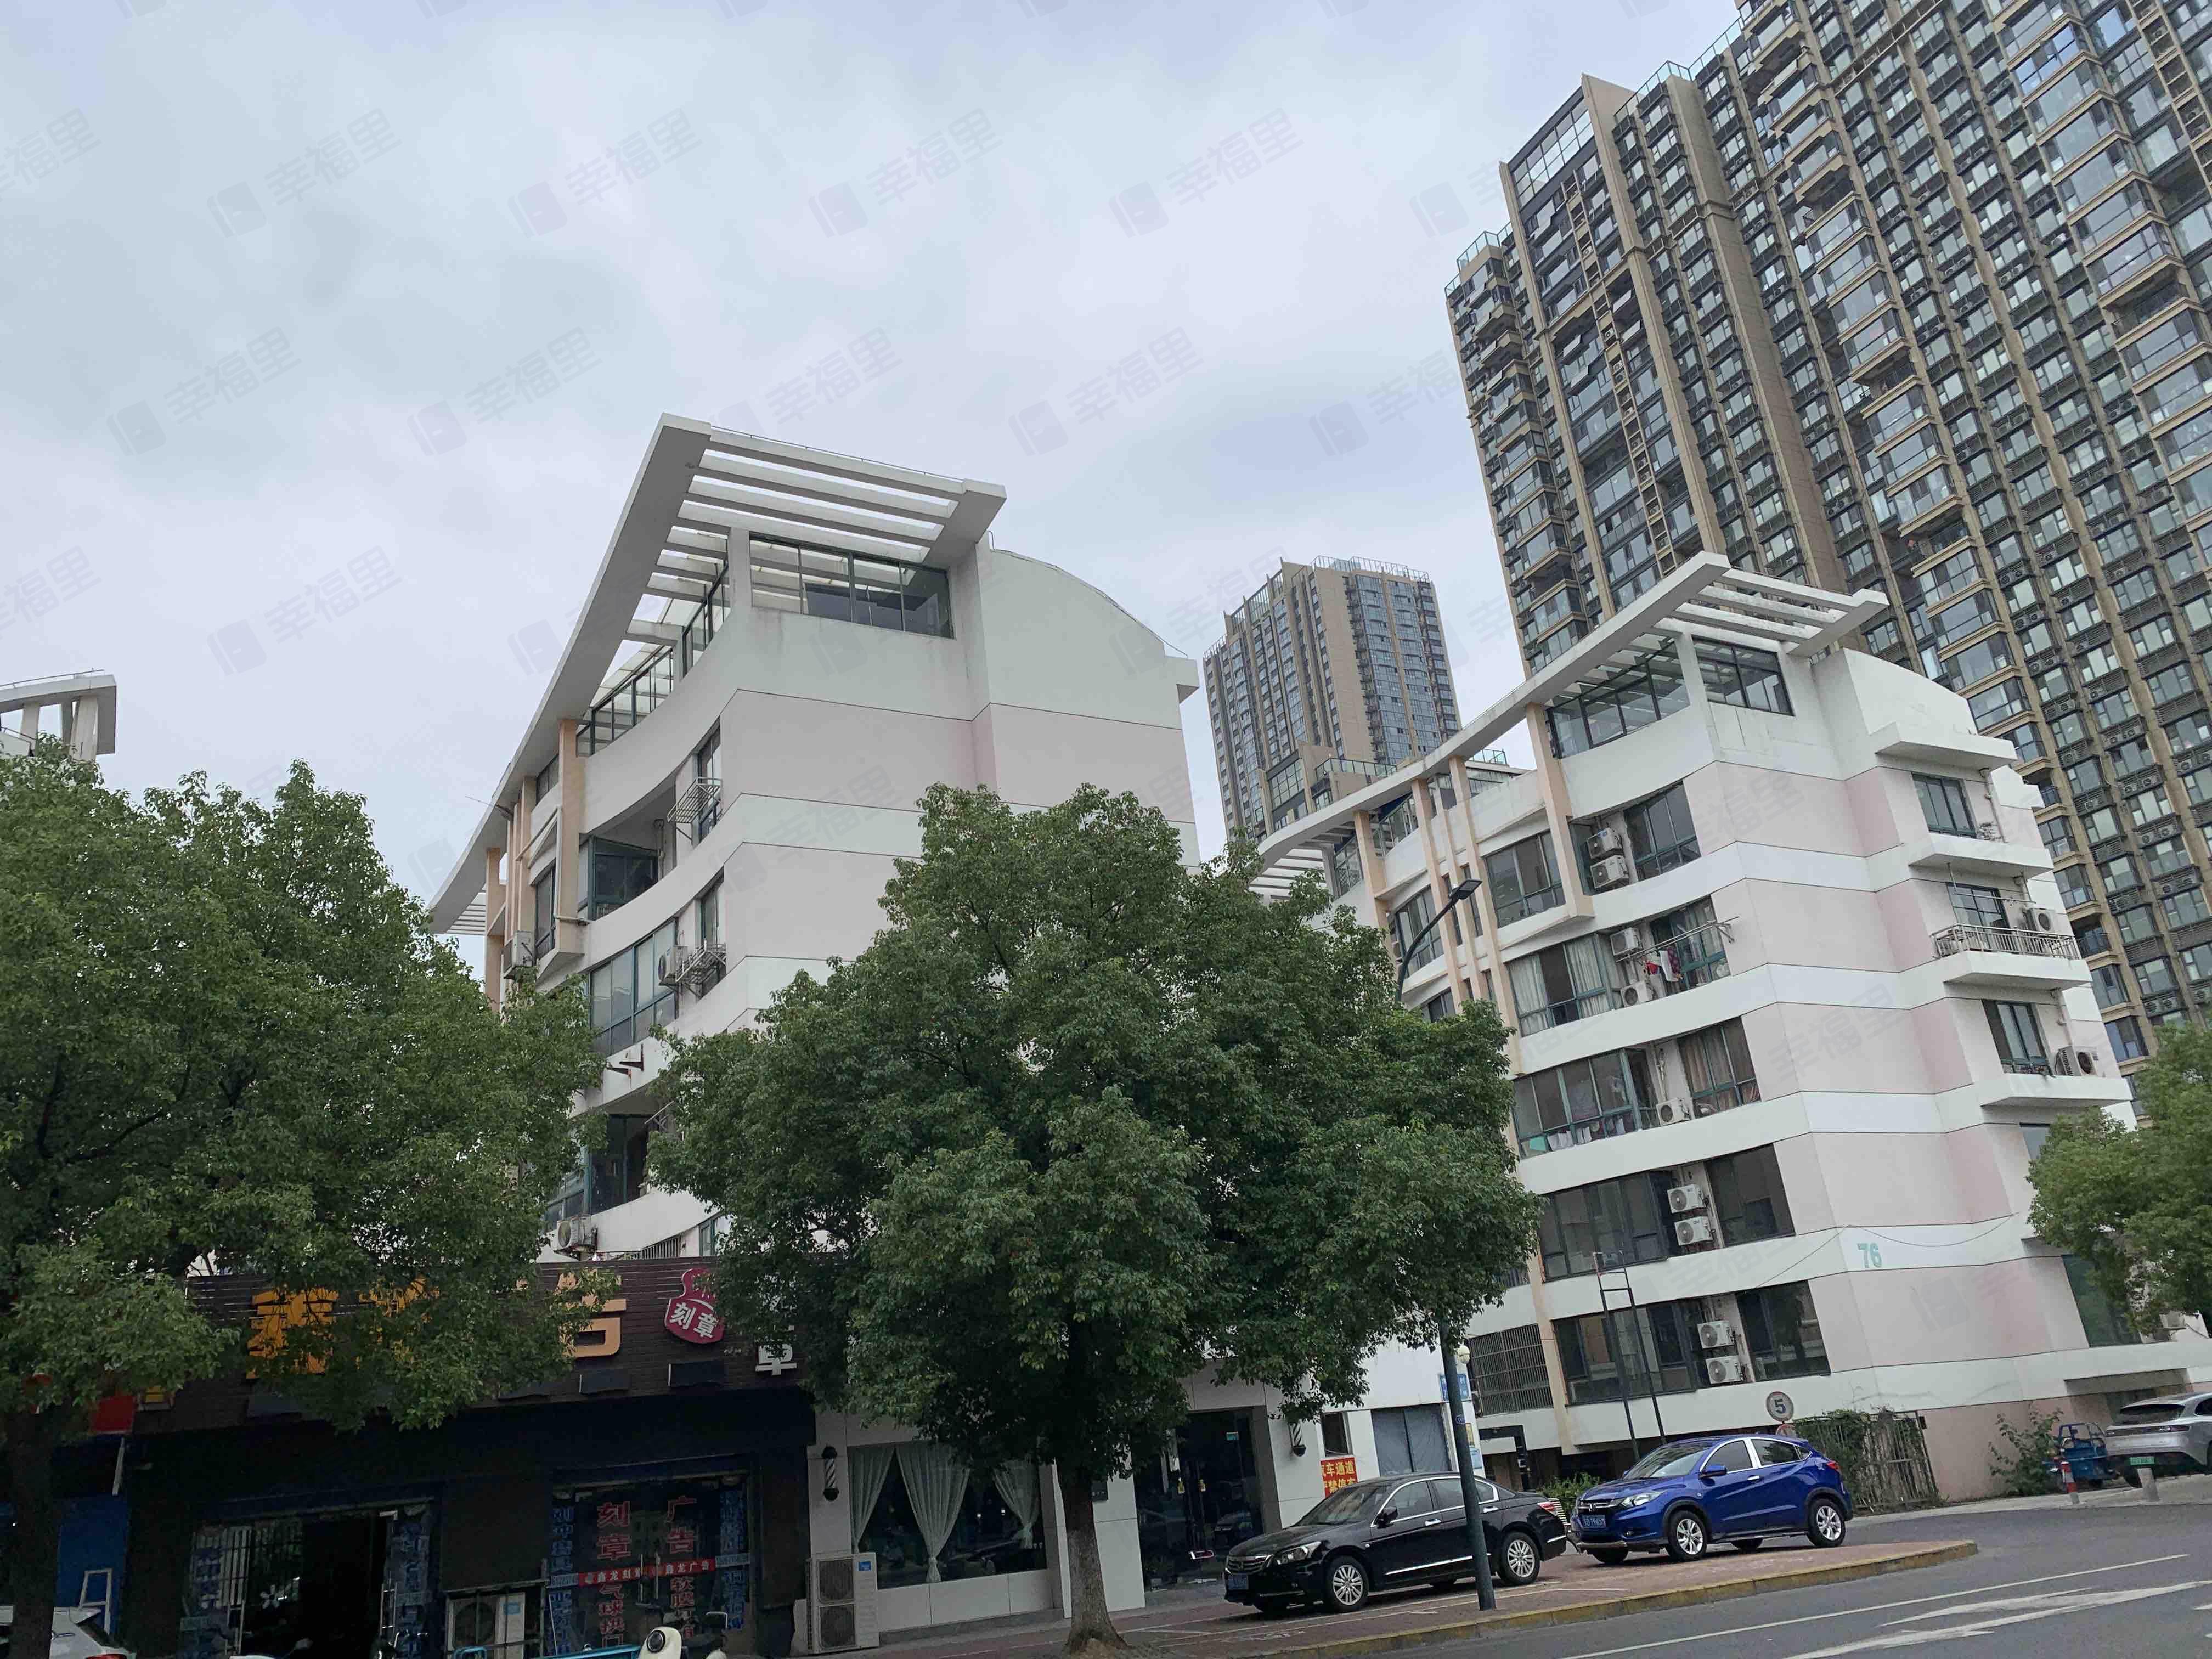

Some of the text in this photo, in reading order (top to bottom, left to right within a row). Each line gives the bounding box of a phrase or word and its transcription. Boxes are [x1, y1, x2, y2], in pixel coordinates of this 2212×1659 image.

[1857, 1243, 1882, 1268] 76
[669, 1302, 719, 1338] 刻章
[1774, 1398, 1786, 1414] 5
[596, 1500, 631, 1561] 刻章
[666, 1495, 697, 1554] 广告
